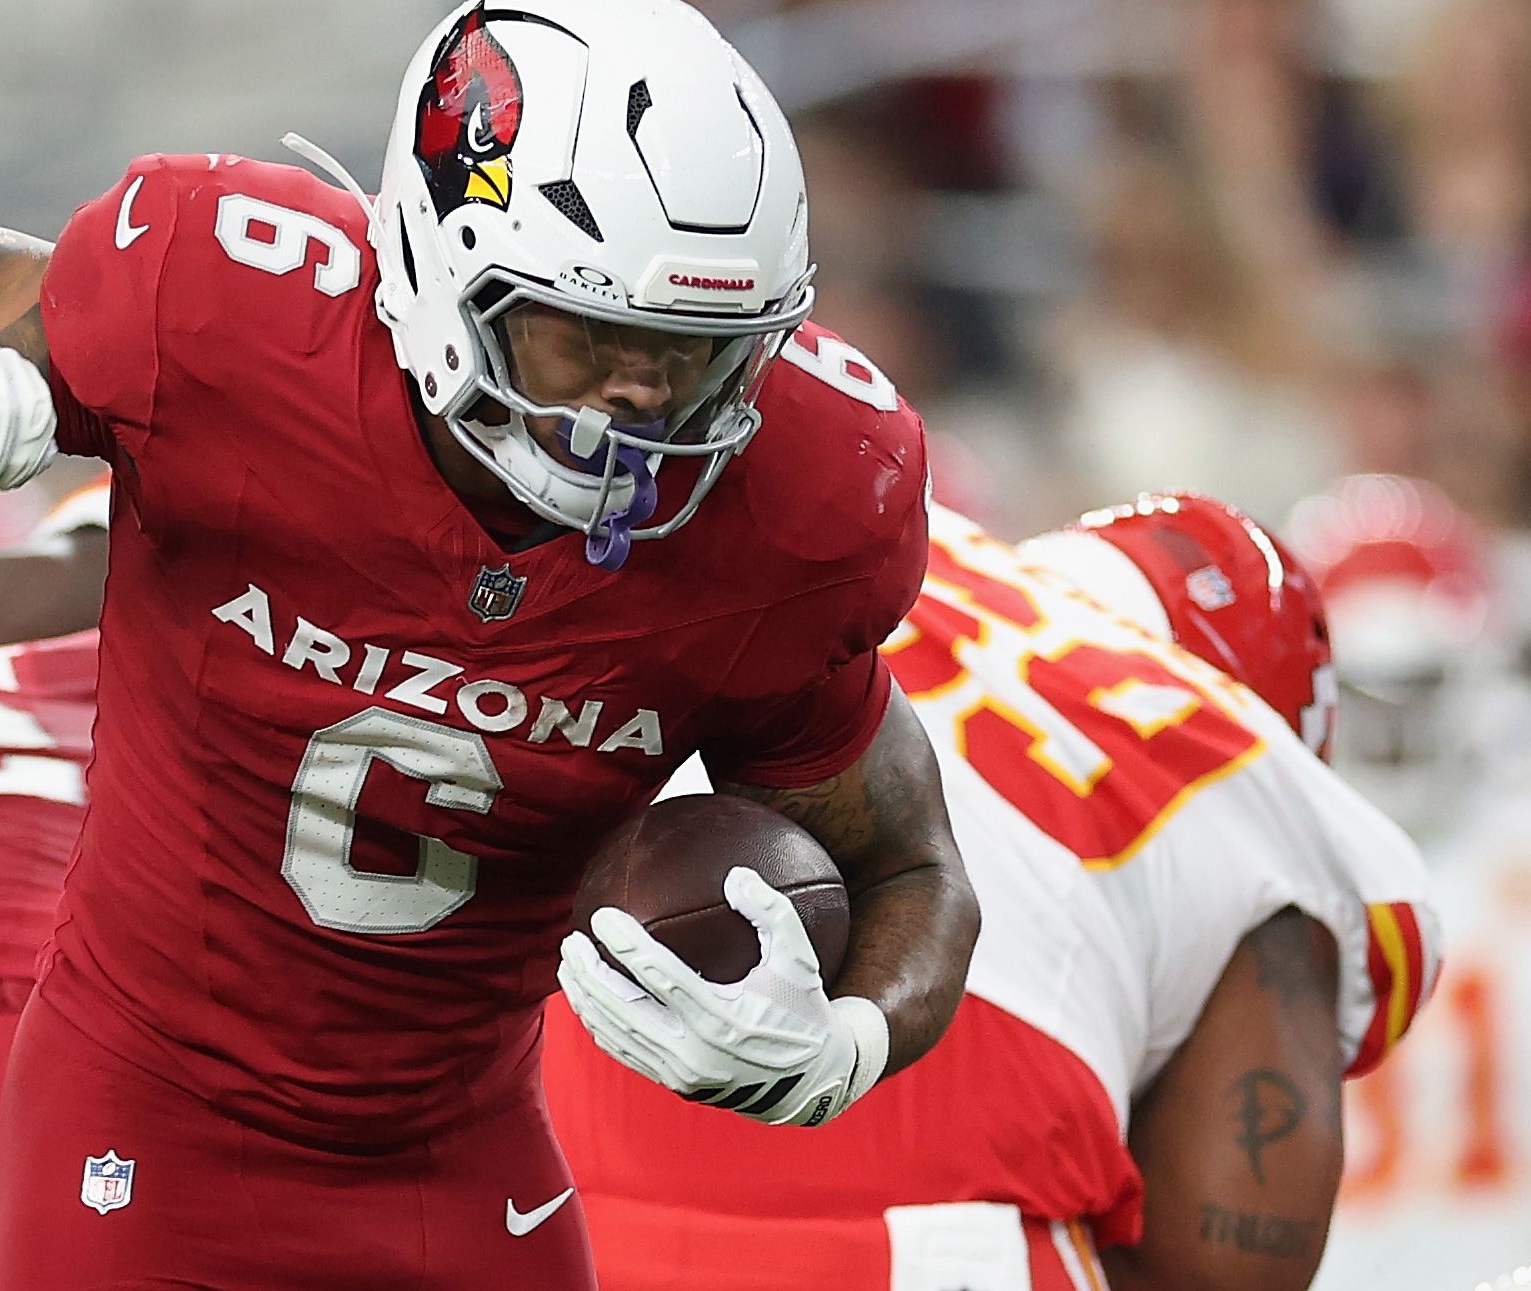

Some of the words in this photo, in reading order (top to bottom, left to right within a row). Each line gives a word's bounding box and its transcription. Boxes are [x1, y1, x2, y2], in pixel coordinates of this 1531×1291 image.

[213, 193, 362, 298] 6
[669, 273, 756, 291] CARDINALS
[211, 583, 665, 756] ARIZONA
